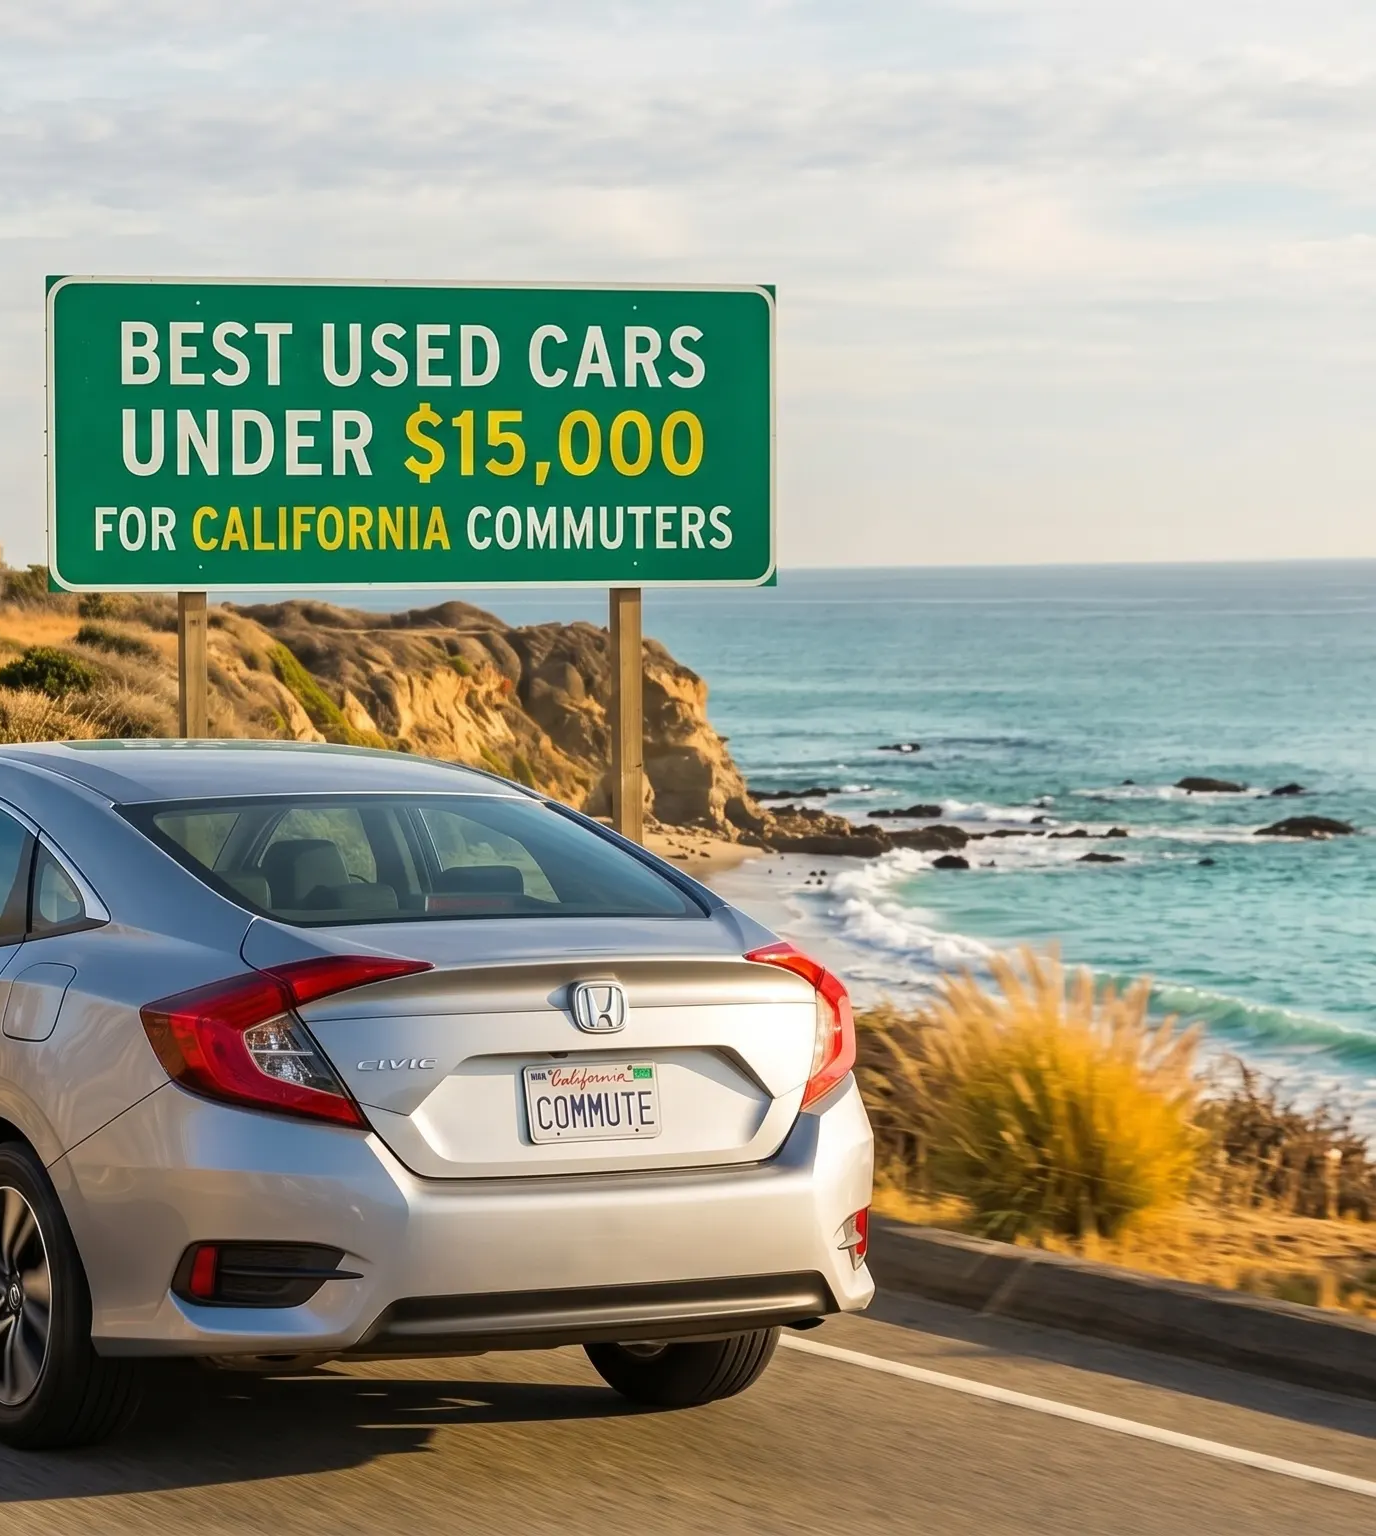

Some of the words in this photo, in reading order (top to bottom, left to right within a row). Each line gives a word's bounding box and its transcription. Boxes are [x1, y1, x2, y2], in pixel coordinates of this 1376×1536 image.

[121, 321, 293, 387] BEST
[322, 322, 500, 387] USED
[528, 324, 706, 389] CARS
[122, 408, 373, 477] UNDER
[403, 402, 704, 486] $15,000
[95, 506, 177, 552] FOR
[192, 505, 451, 551] CALIFORNIA
[466, 505, 733, 550] COMMUTERS
[356, 1058, 438, 1072] CIVIC
[551, 1065, 633, 1090] California
[536, 1091, 655, 1130] COMMUTE
